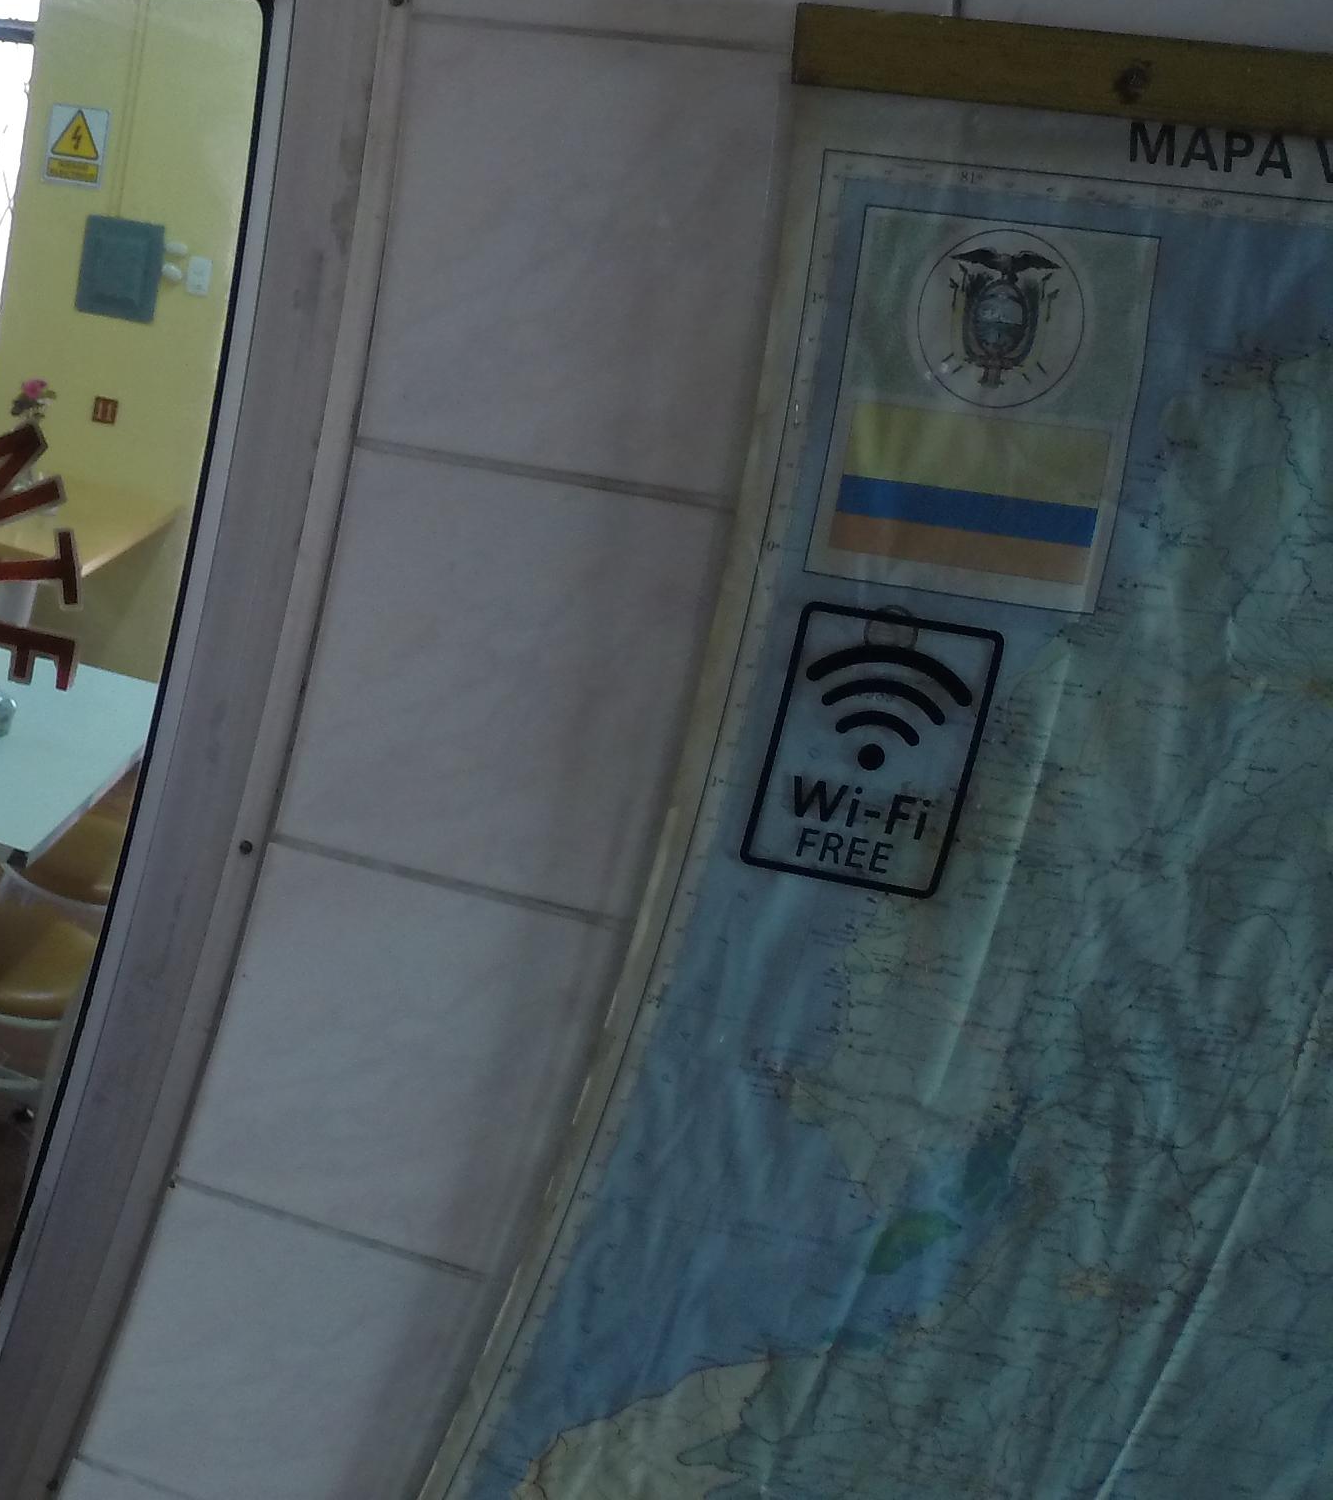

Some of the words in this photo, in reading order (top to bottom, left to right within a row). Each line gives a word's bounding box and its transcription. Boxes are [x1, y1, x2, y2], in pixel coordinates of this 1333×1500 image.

[1129, 121, 1293, 180] MAPA
[791, 774, 933, 841] Wi-Fi
[795, 827, 894, 875] FREE
